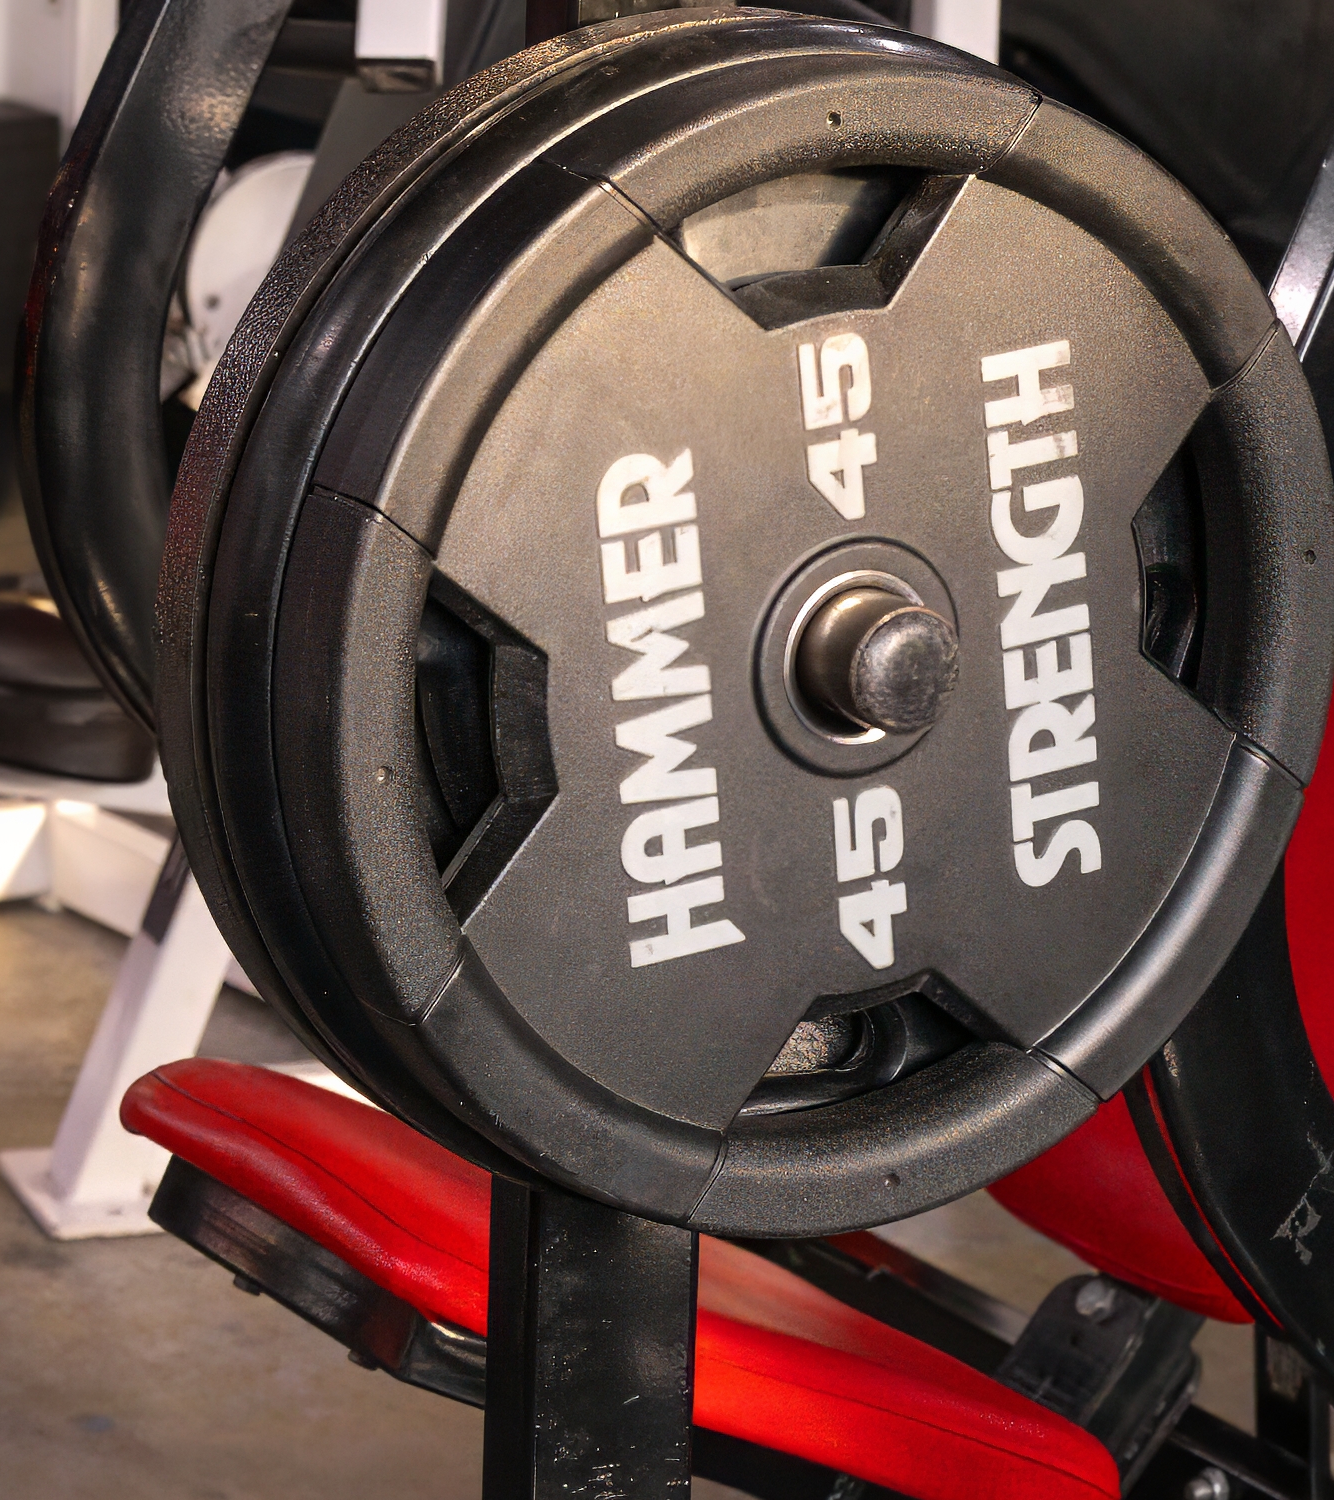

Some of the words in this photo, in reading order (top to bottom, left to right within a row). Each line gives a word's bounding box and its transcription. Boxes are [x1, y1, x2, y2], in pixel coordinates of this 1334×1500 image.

[797, 332, 877, 520] 45
[597, 447, 746, 968] HAMMER
[980, 340, 1102, 888] STRENGTH
[833, 787, 908, 969] 45
